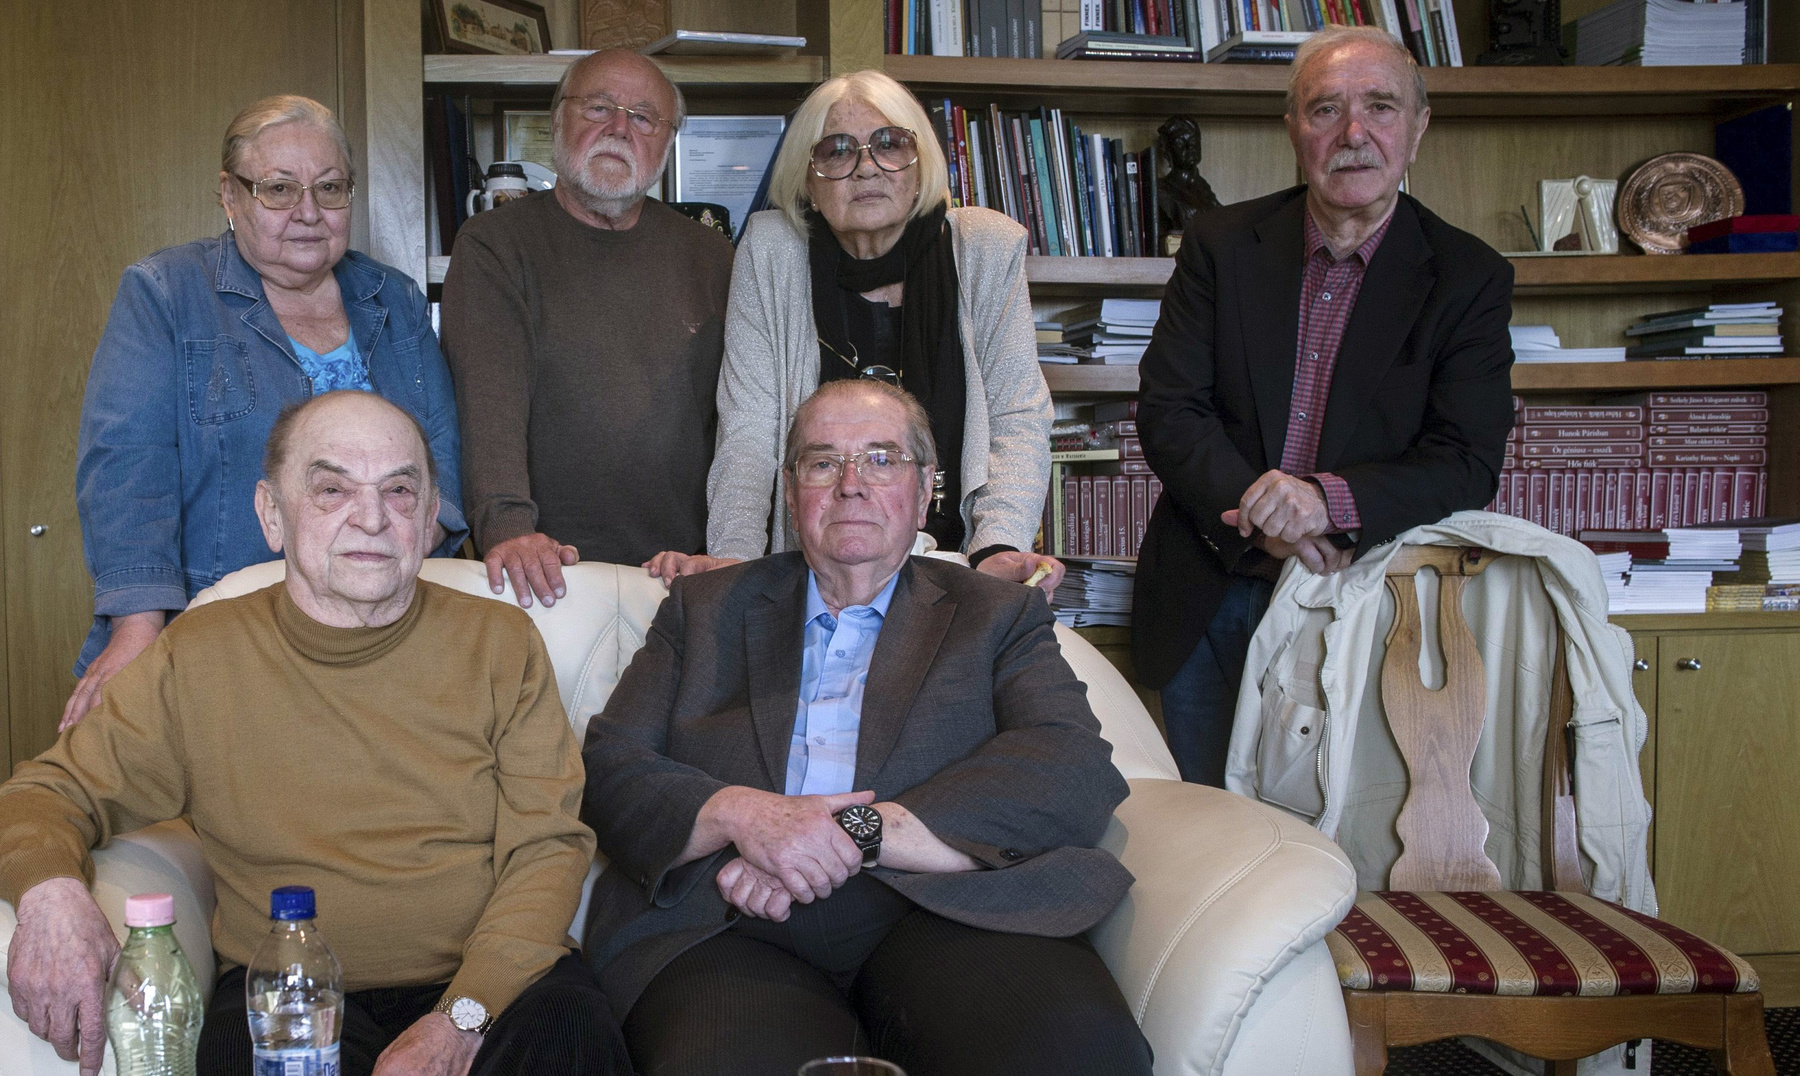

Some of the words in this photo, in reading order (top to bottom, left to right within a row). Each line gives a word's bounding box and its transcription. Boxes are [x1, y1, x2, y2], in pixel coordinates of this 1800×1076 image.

[1558, 429, 1580, 437] Hunok
[1582, 429, 1609, 437] Párisban
[1719, 502, 1728, 521] lauza
[1067, 513, 1077, 549] tragédiája
[1083, 520, 1091, 542] virágok
